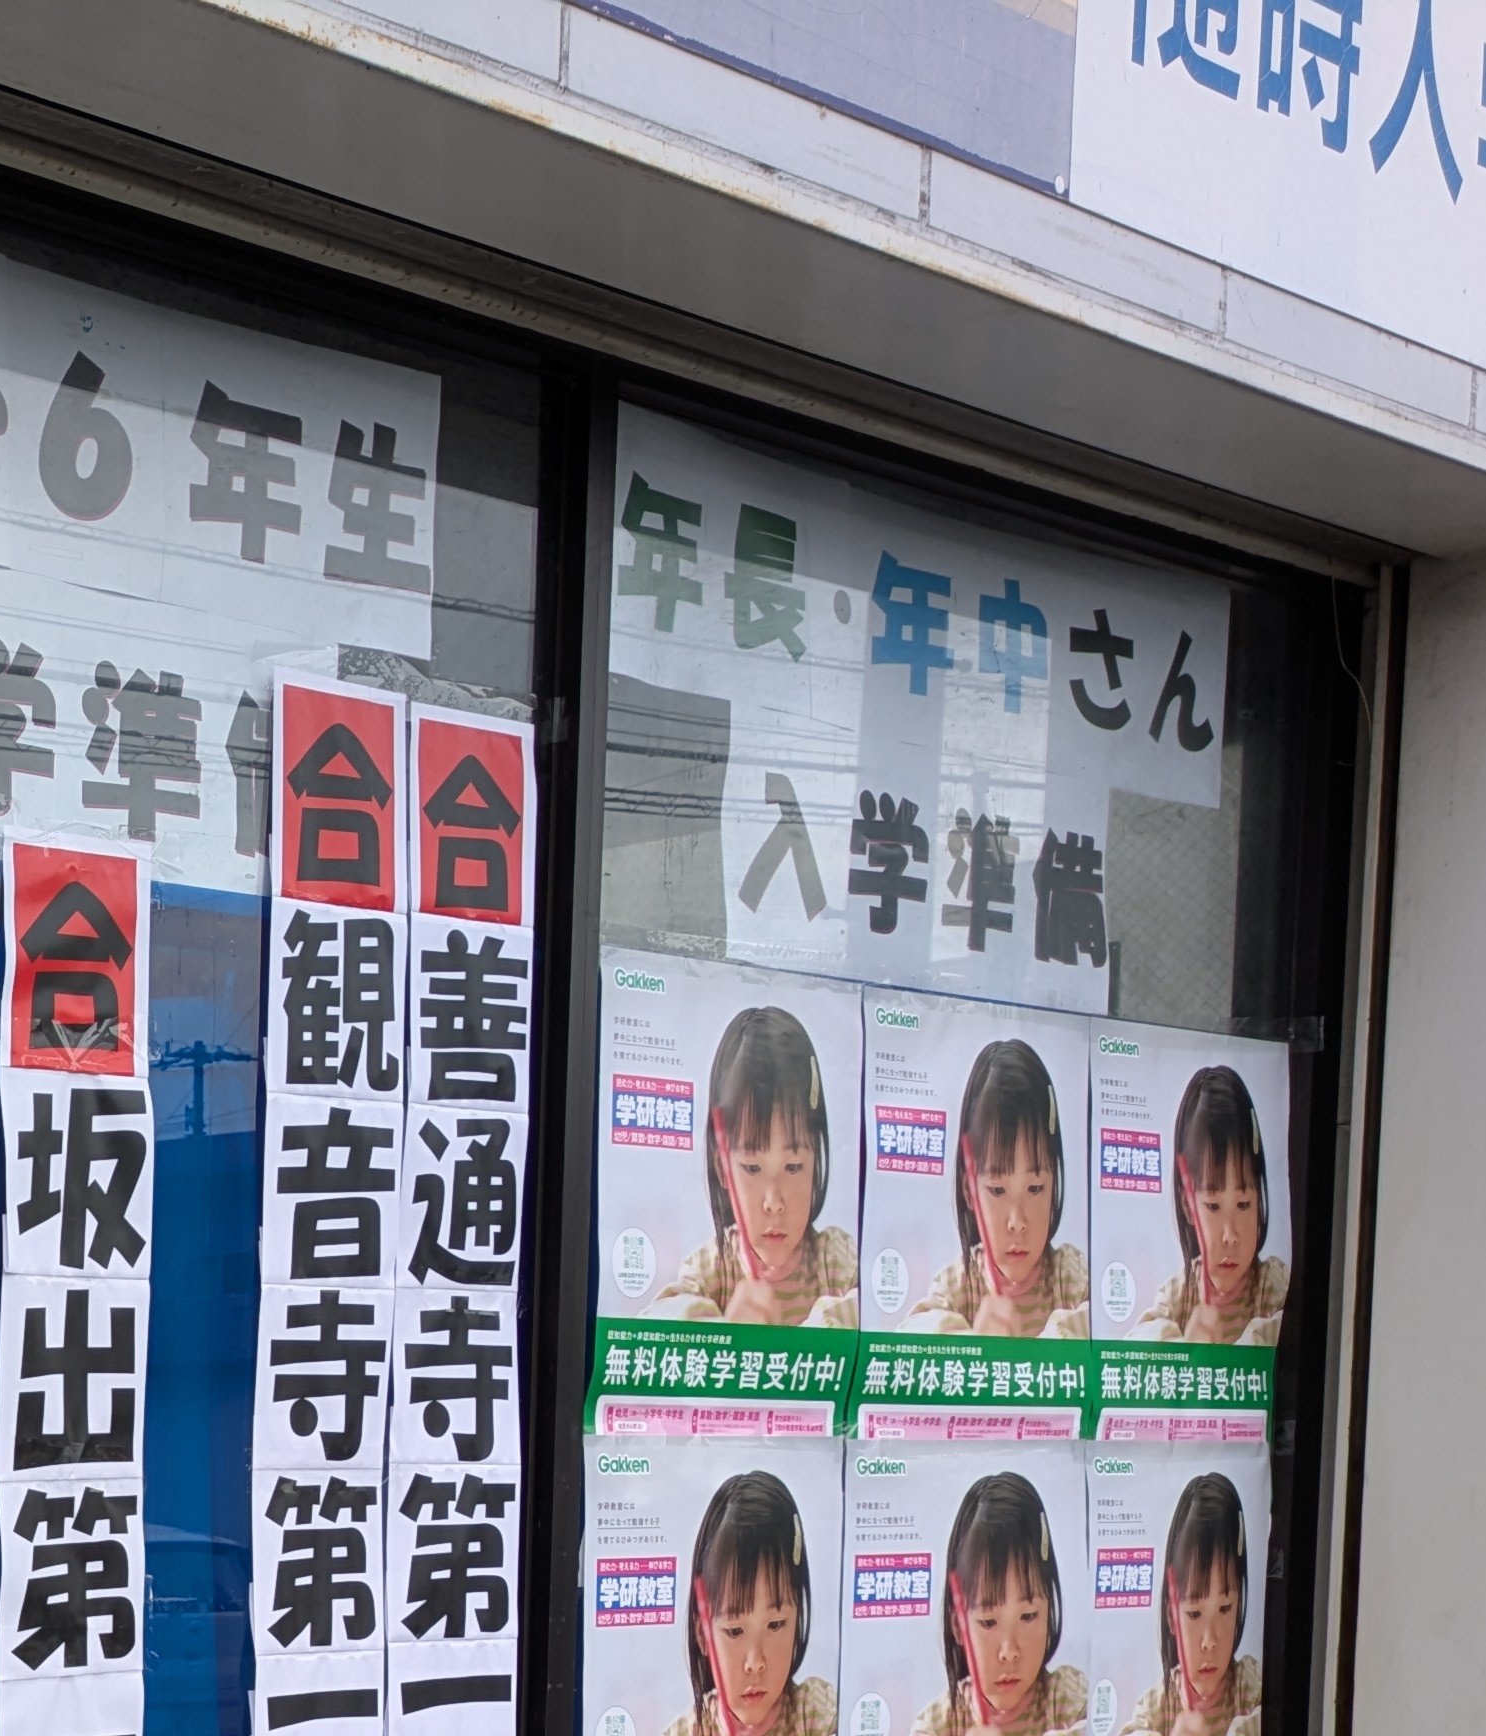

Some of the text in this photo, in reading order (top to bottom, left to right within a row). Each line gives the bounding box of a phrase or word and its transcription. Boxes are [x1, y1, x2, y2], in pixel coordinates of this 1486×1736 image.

[1131, 0, 1486, 205] 時入
[617, 470, 1215, 754] 年長・年中さん
[737, 770, 1109, 969] 入学準備
[614, 968, 665, 992] Gakken
[876, 1007, 919, 1029] Gakken
[1099, 1036, 1140, 1057] Gakken
[616, 1094, 692, 1132] 学研教室
[879, 1123, 944, 1158] 学研教室
[1103, 1145, 1160, 1176] 学研教室
[602, 1344, 846, 1392] 無料体験学習受付中!
[597, 1455, 650, 1474] Gakken
[856, 1458, 906, 1476] Gakken
[1094, 1458, 1134, 1475] Gakken
[600, 1576, 675, 1608] 学研教室
[857, 1570, 929, 1601] 学研教室
[1098, 1565, 1152, 1593] 学研教室
